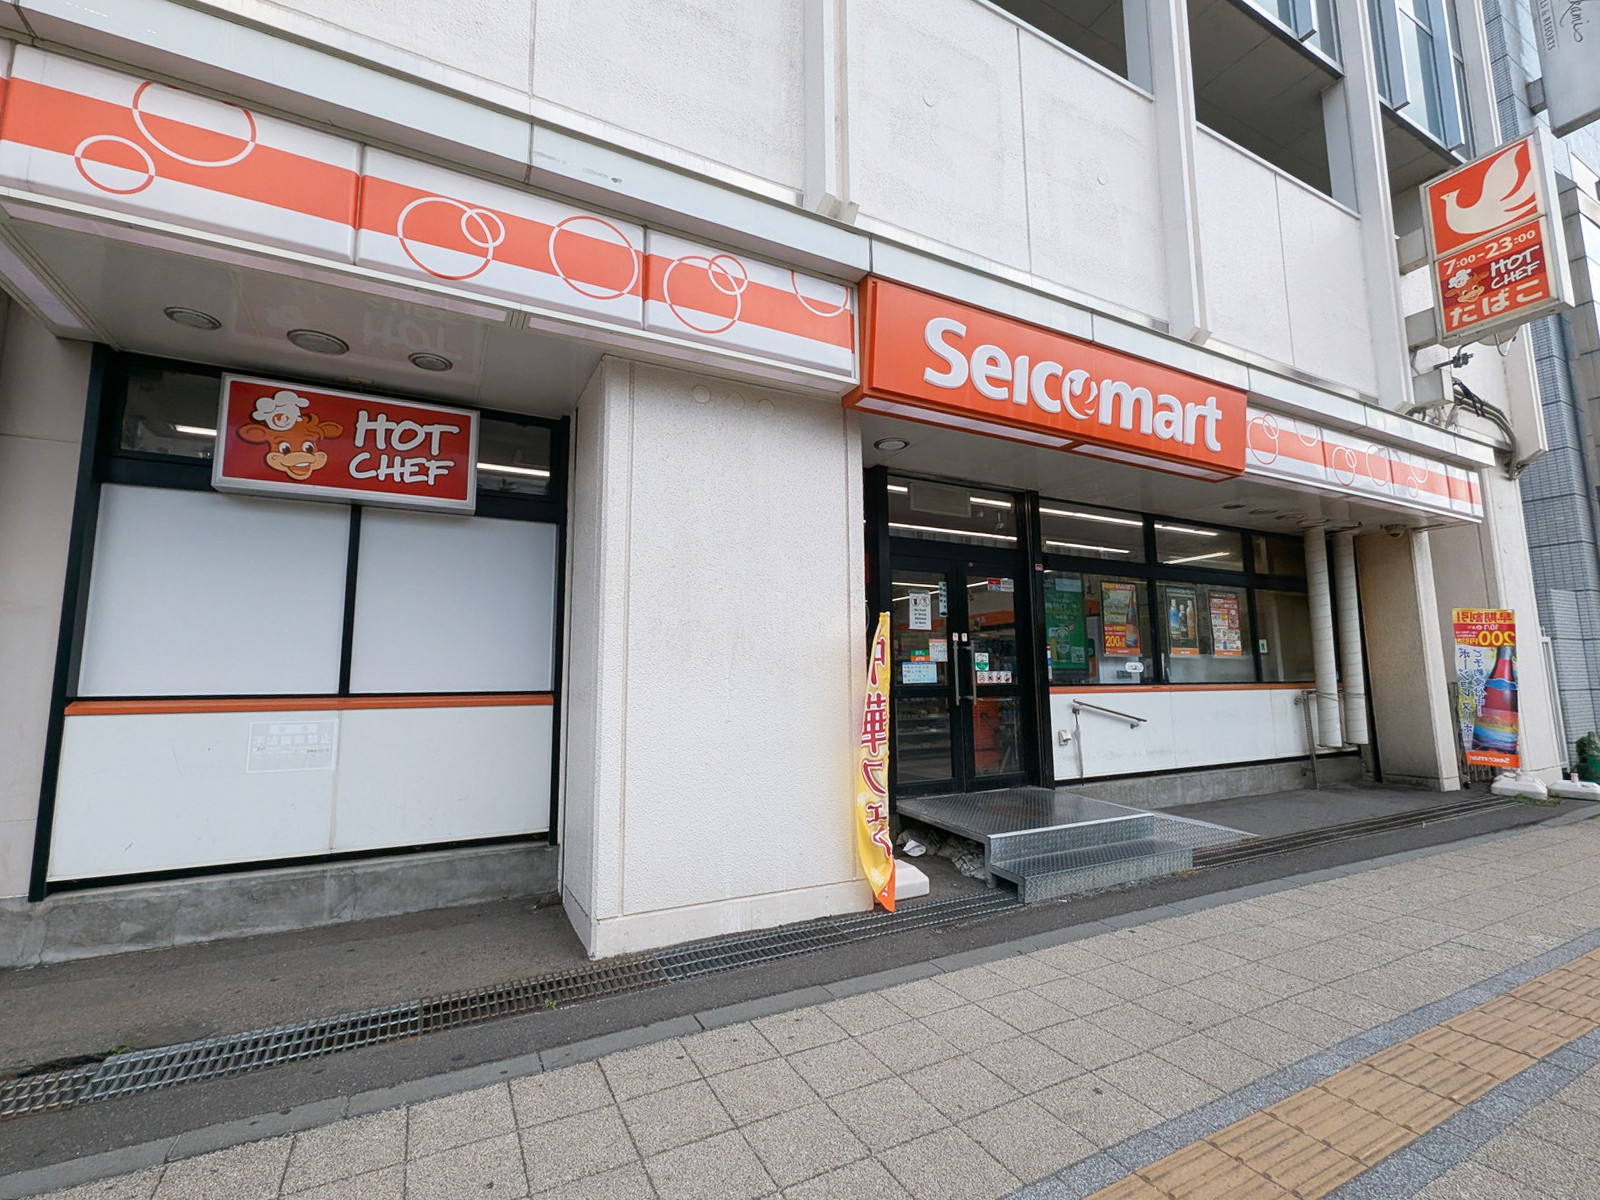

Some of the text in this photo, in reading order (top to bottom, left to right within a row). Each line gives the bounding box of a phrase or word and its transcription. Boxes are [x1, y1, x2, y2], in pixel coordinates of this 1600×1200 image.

[1542, 16, 1556, 51] RESORTS
[1490, 245, 1540, 277] HOT
[1490, 260, 1540, 289] CHEF
[1449, 280, 1543, 327] たばこ
[923, 317, 1223, 453] Seicomart
[354, 409, 461, 456] HOT
[349, 452, 455, 486] CHEF
